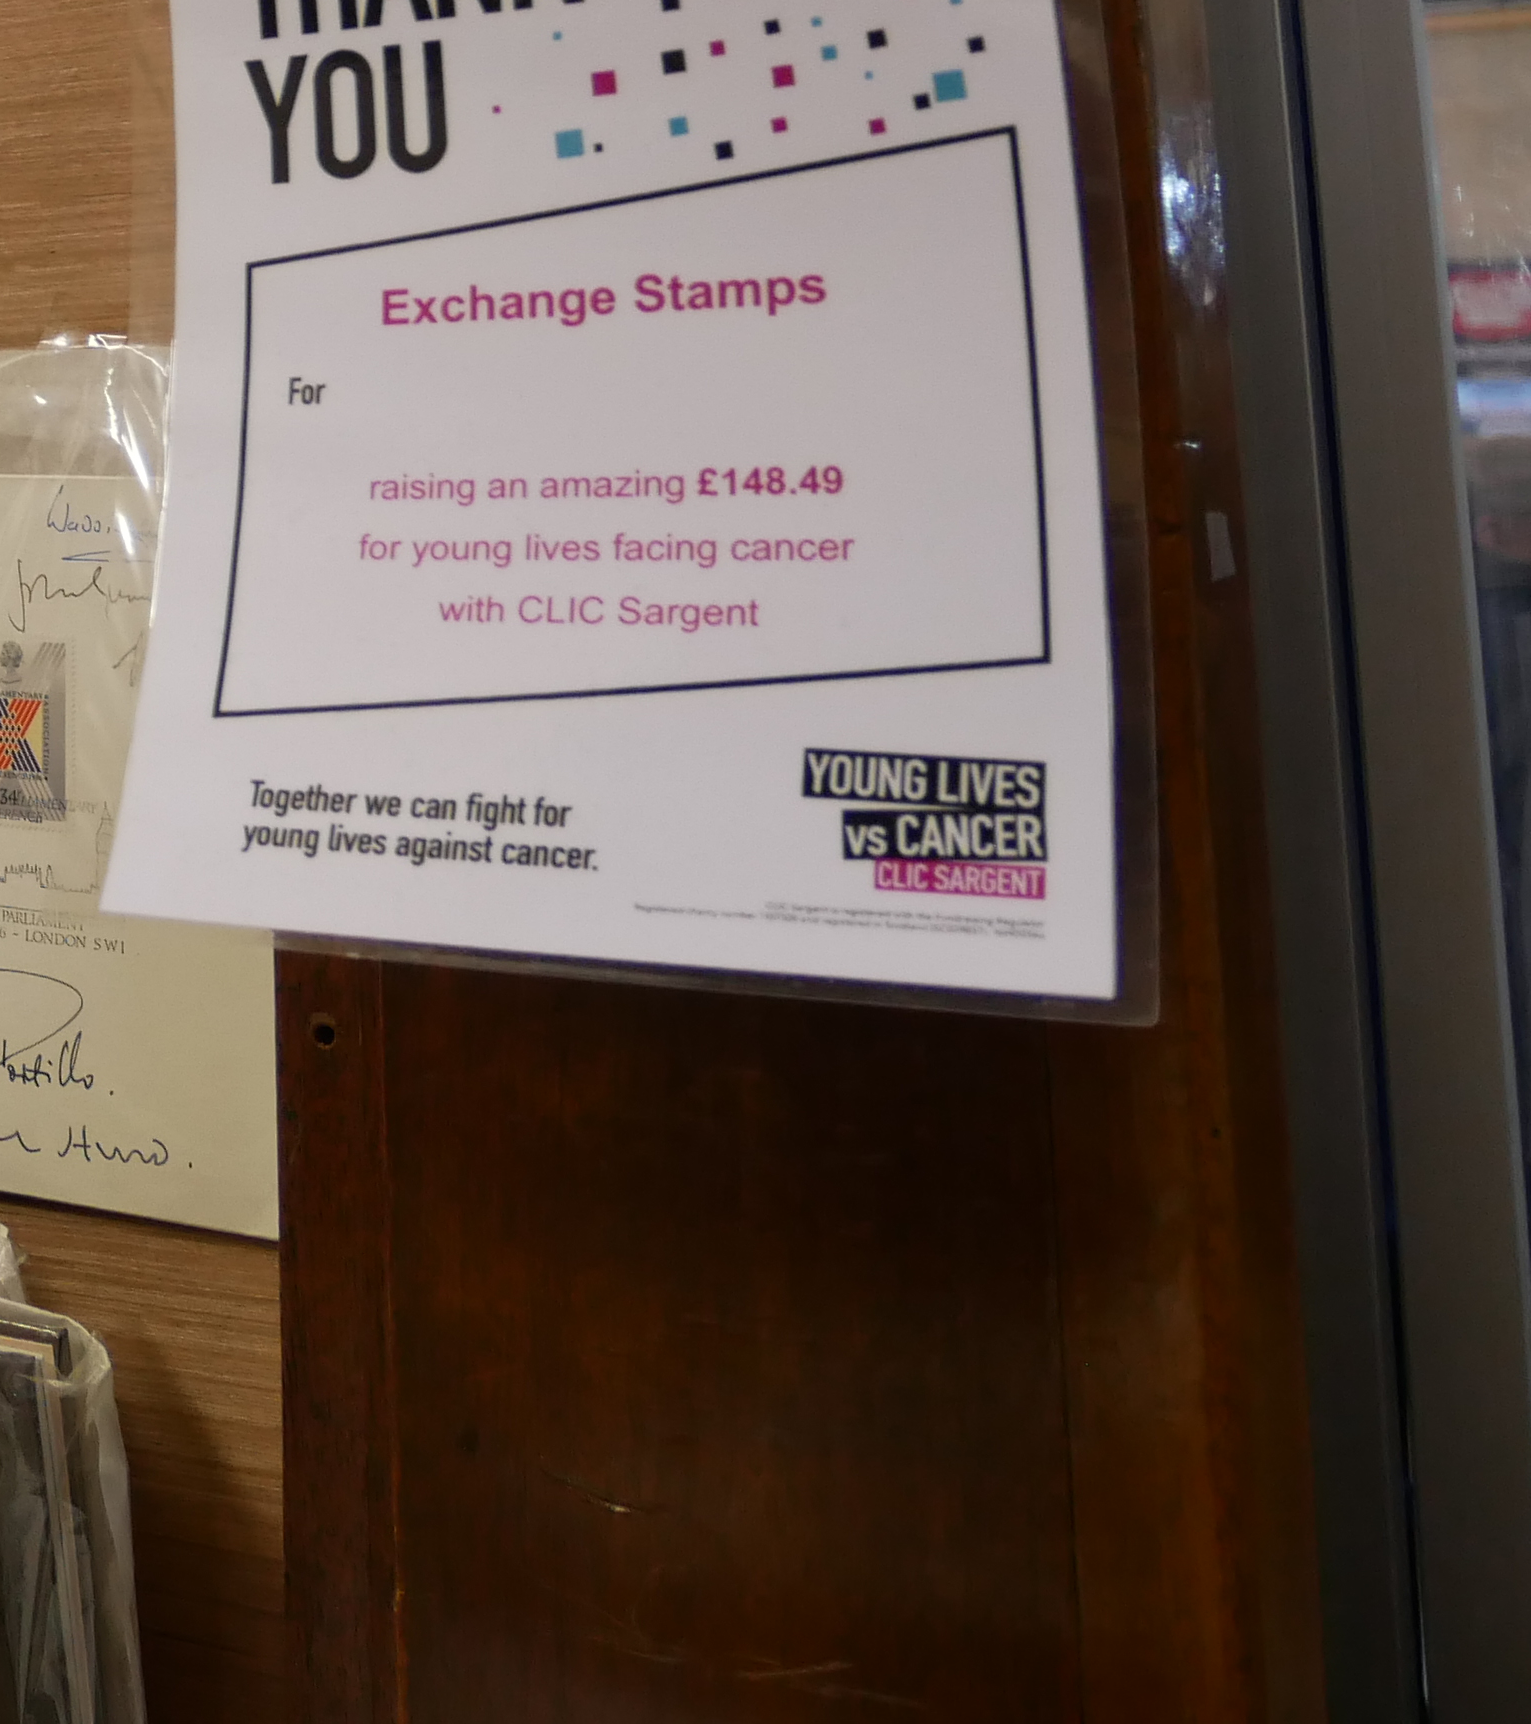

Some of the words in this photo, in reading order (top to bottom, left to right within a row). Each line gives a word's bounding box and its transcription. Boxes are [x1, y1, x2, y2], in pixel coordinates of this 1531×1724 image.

[242, 39, 450, 185] YOU
[379, 279, 617, 327] Exchange
[632, 269, 829, 319] Stamps
[287, 375, 327, 408] For
[369, 473, 476, 507] raising
[487, 478, 529, 501] an
[539, 470, 686, 504] amazing
[697, 465, 845, 497] £148.49
[359, 533, 401, 561] for
[412, 538, 512, 568] young
[526, 533, 601, 561] lives
[613, 532, 717, 568] facing
[730, 534, 855, 562] cancer
[439, 597, 505, 624] with
[518, 595, 605, 626] CLIC
[618, 596, 760, 633] Sargent
[805, 751, 928, 801] YOUNG
[936, 761, 1041, 810] LIVES
[249, 779, 357, 818] Together
[364, 794, 401, 817] we
[410, 796, 457, 821] can
[466, 792, 527, 831] fight
[533, 796, 573, 828] for
[241, 823, 319, 857] young
[328, 823, 387, 855] lives
[394, 831, 493, 866] against
[500, 839, 599, 871] cancer.
[896, 813, 1044, 858] CANCER
[877, 860, 929, 891] CLIC
[934, 865, 1042, 897] SARGENT
[25, 929, 87, 948] LONDON
